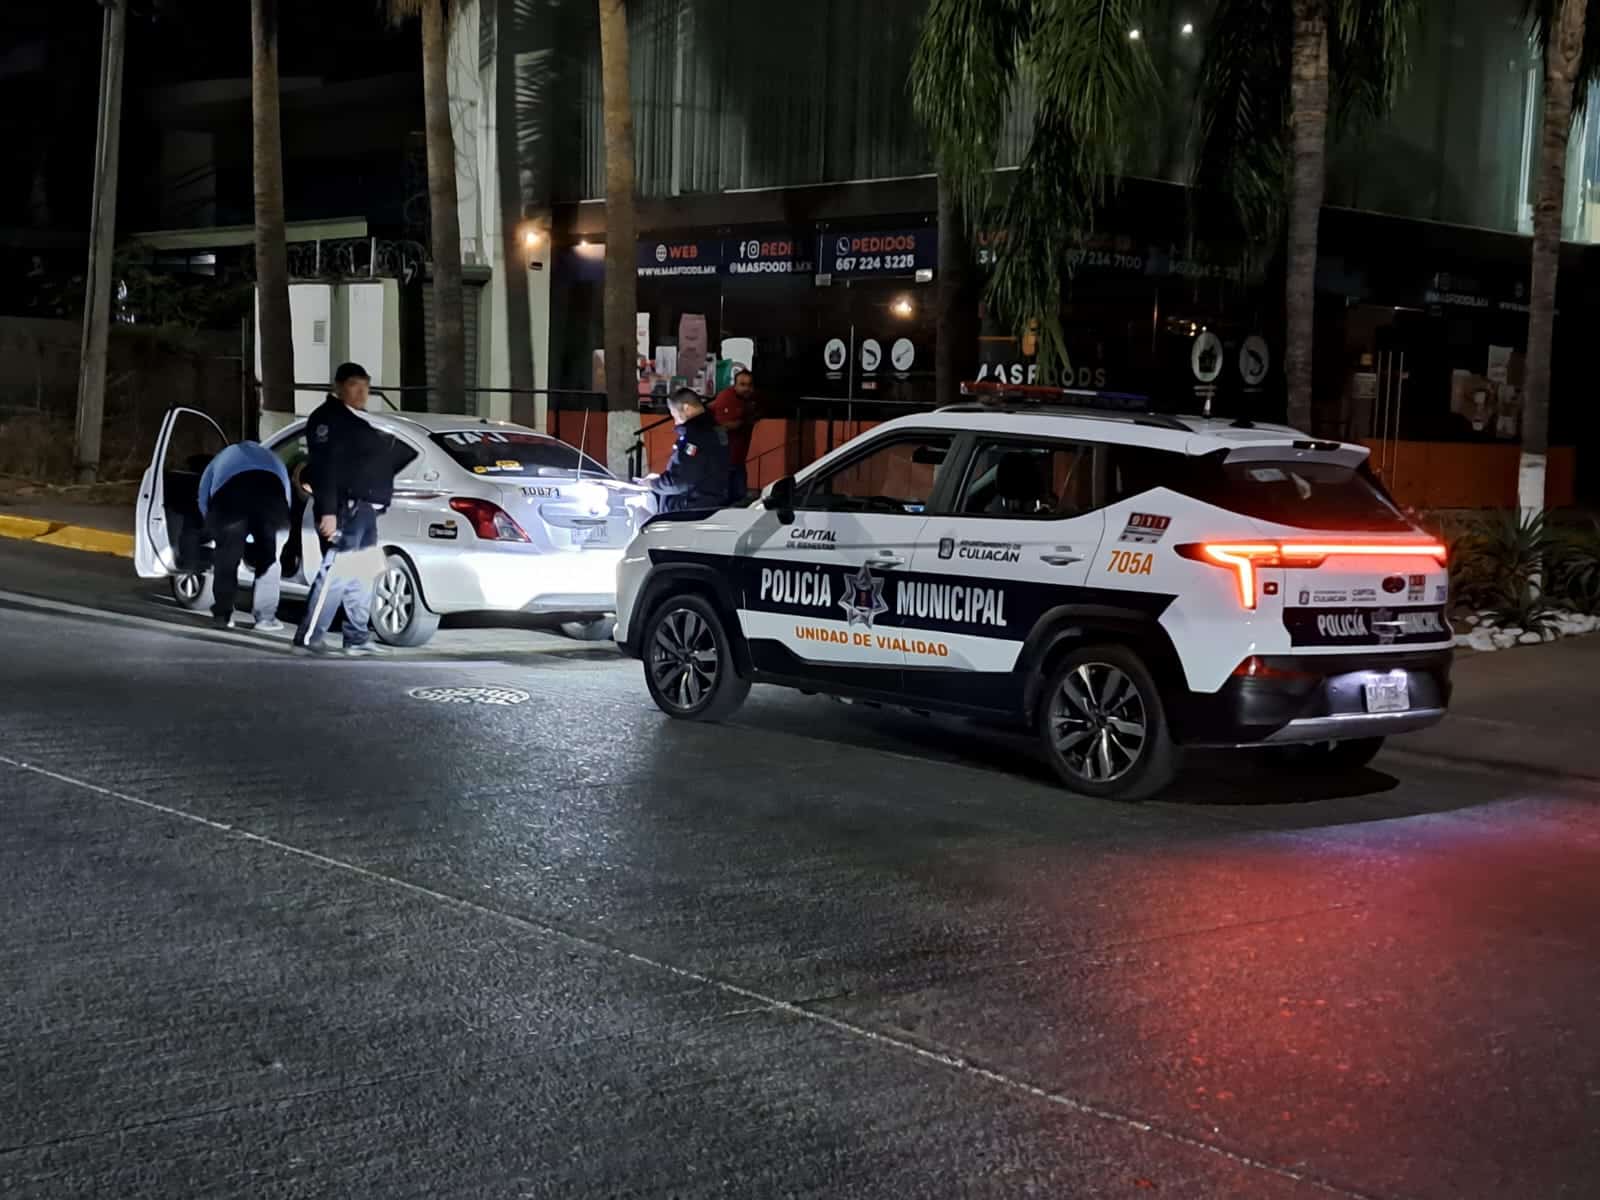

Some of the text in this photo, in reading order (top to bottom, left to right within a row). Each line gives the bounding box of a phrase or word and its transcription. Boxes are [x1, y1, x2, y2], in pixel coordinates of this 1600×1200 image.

[669, 245, 698, 259] WEB
[851, 236, 915, 252] PEDIDOS
[858, 256, 881, 270] 224
[975, 363, 1107, 388] ASFODS
[791, 528, 837, 542] CAPITAL
[1107, 551, 1153, 575] 705A
[760, 565, 1007, 627] POLICÍA MUNICIPAL
[1317, 609, 1368, 636] POLICÍA
[795, 626, 948, 657] UNIDAD DE VIALIDAD
